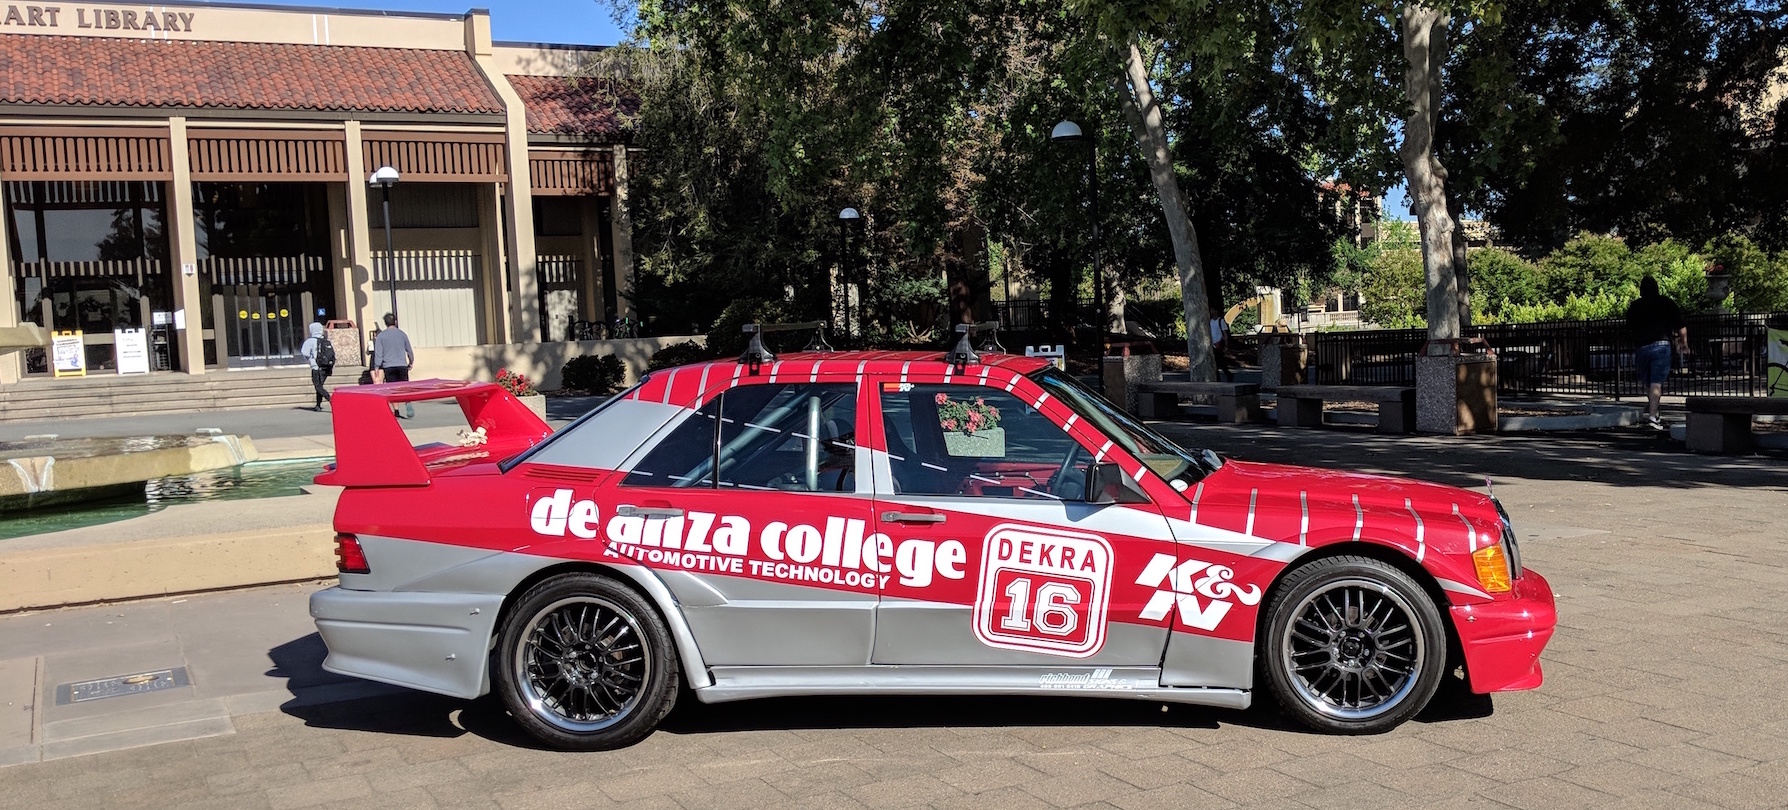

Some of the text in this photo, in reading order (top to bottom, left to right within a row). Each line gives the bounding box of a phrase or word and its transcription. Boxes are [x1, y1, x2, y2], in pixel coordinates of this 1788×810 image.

[0, 5, 195, 32] ART LIBRARY
[530, 488, 967, 588] de anza college
[997, 538, 1096, 573] DEKRA
[603, 542, 891, 590] AUTOMOTIVE TECHNOLOGY
[1000, 577, 1081, 636] 16
